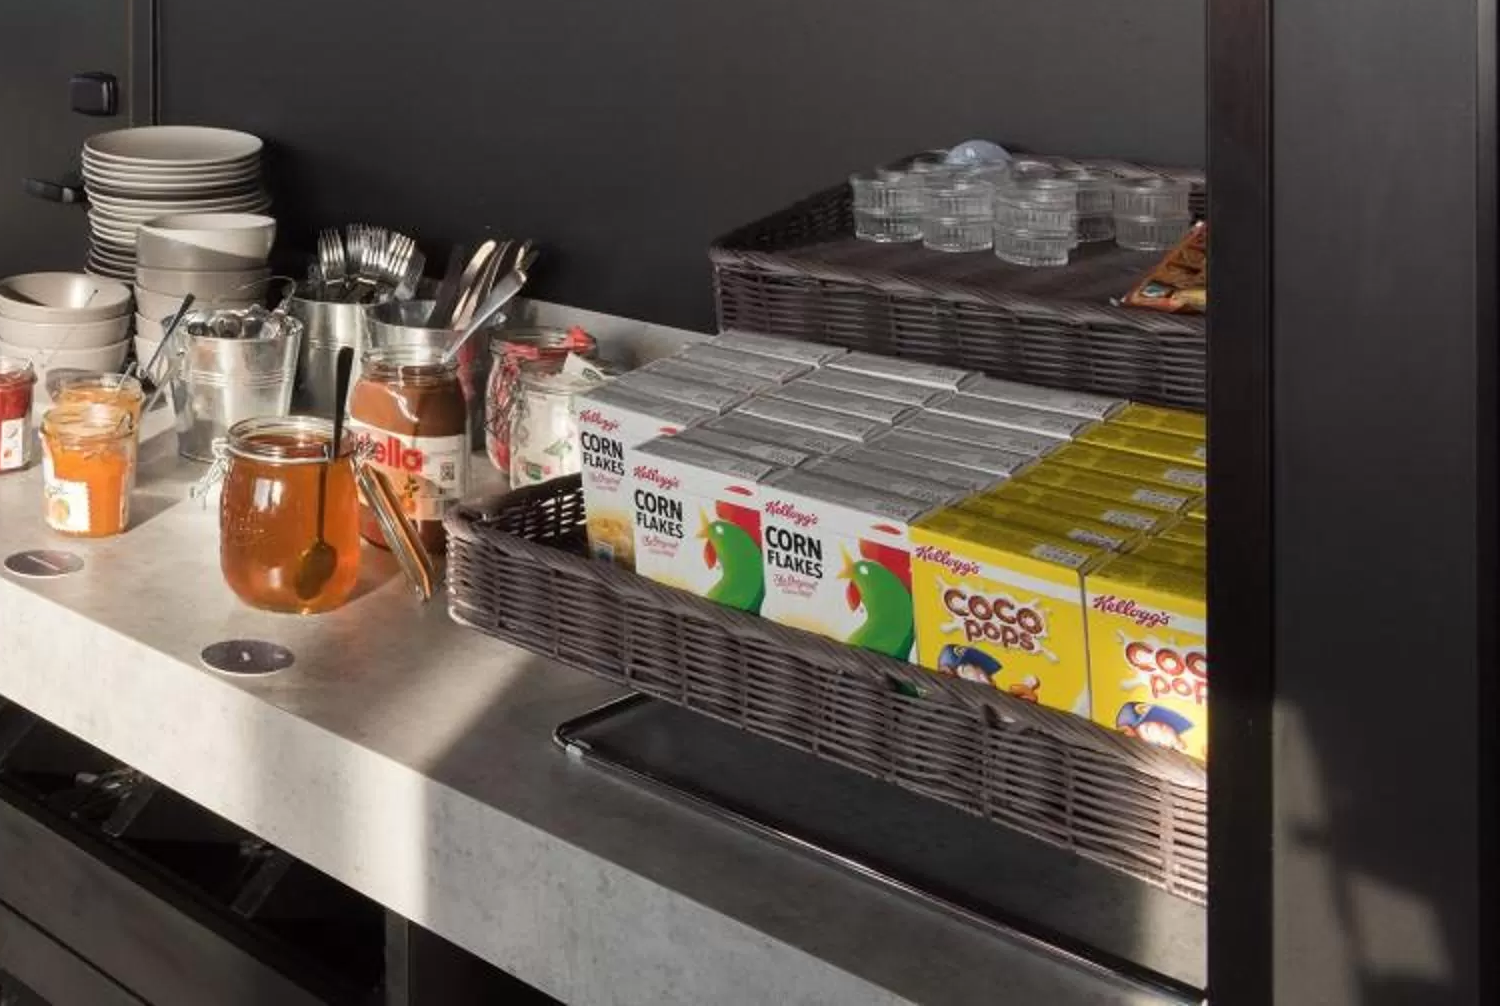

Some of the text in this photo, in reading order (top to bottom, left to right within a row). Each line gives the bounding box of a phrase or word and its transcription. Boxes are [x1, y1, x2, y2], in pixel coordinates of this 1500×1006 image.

[581, 431, 625, 461] CORN
[582, 451, 625, 477] FLAKES
[634, 489, 684, 522] CORN
[764, 500, 819, 527] Kellogg's
[636, 512, 684, 540] FLAKES
[764, 525, 823, 561] CORN
[766, 550, 823, 580] FLAKES
[914, 545, 981, 577] Kellogg's
[1091, 594, 1172, 628] Kellogg's
